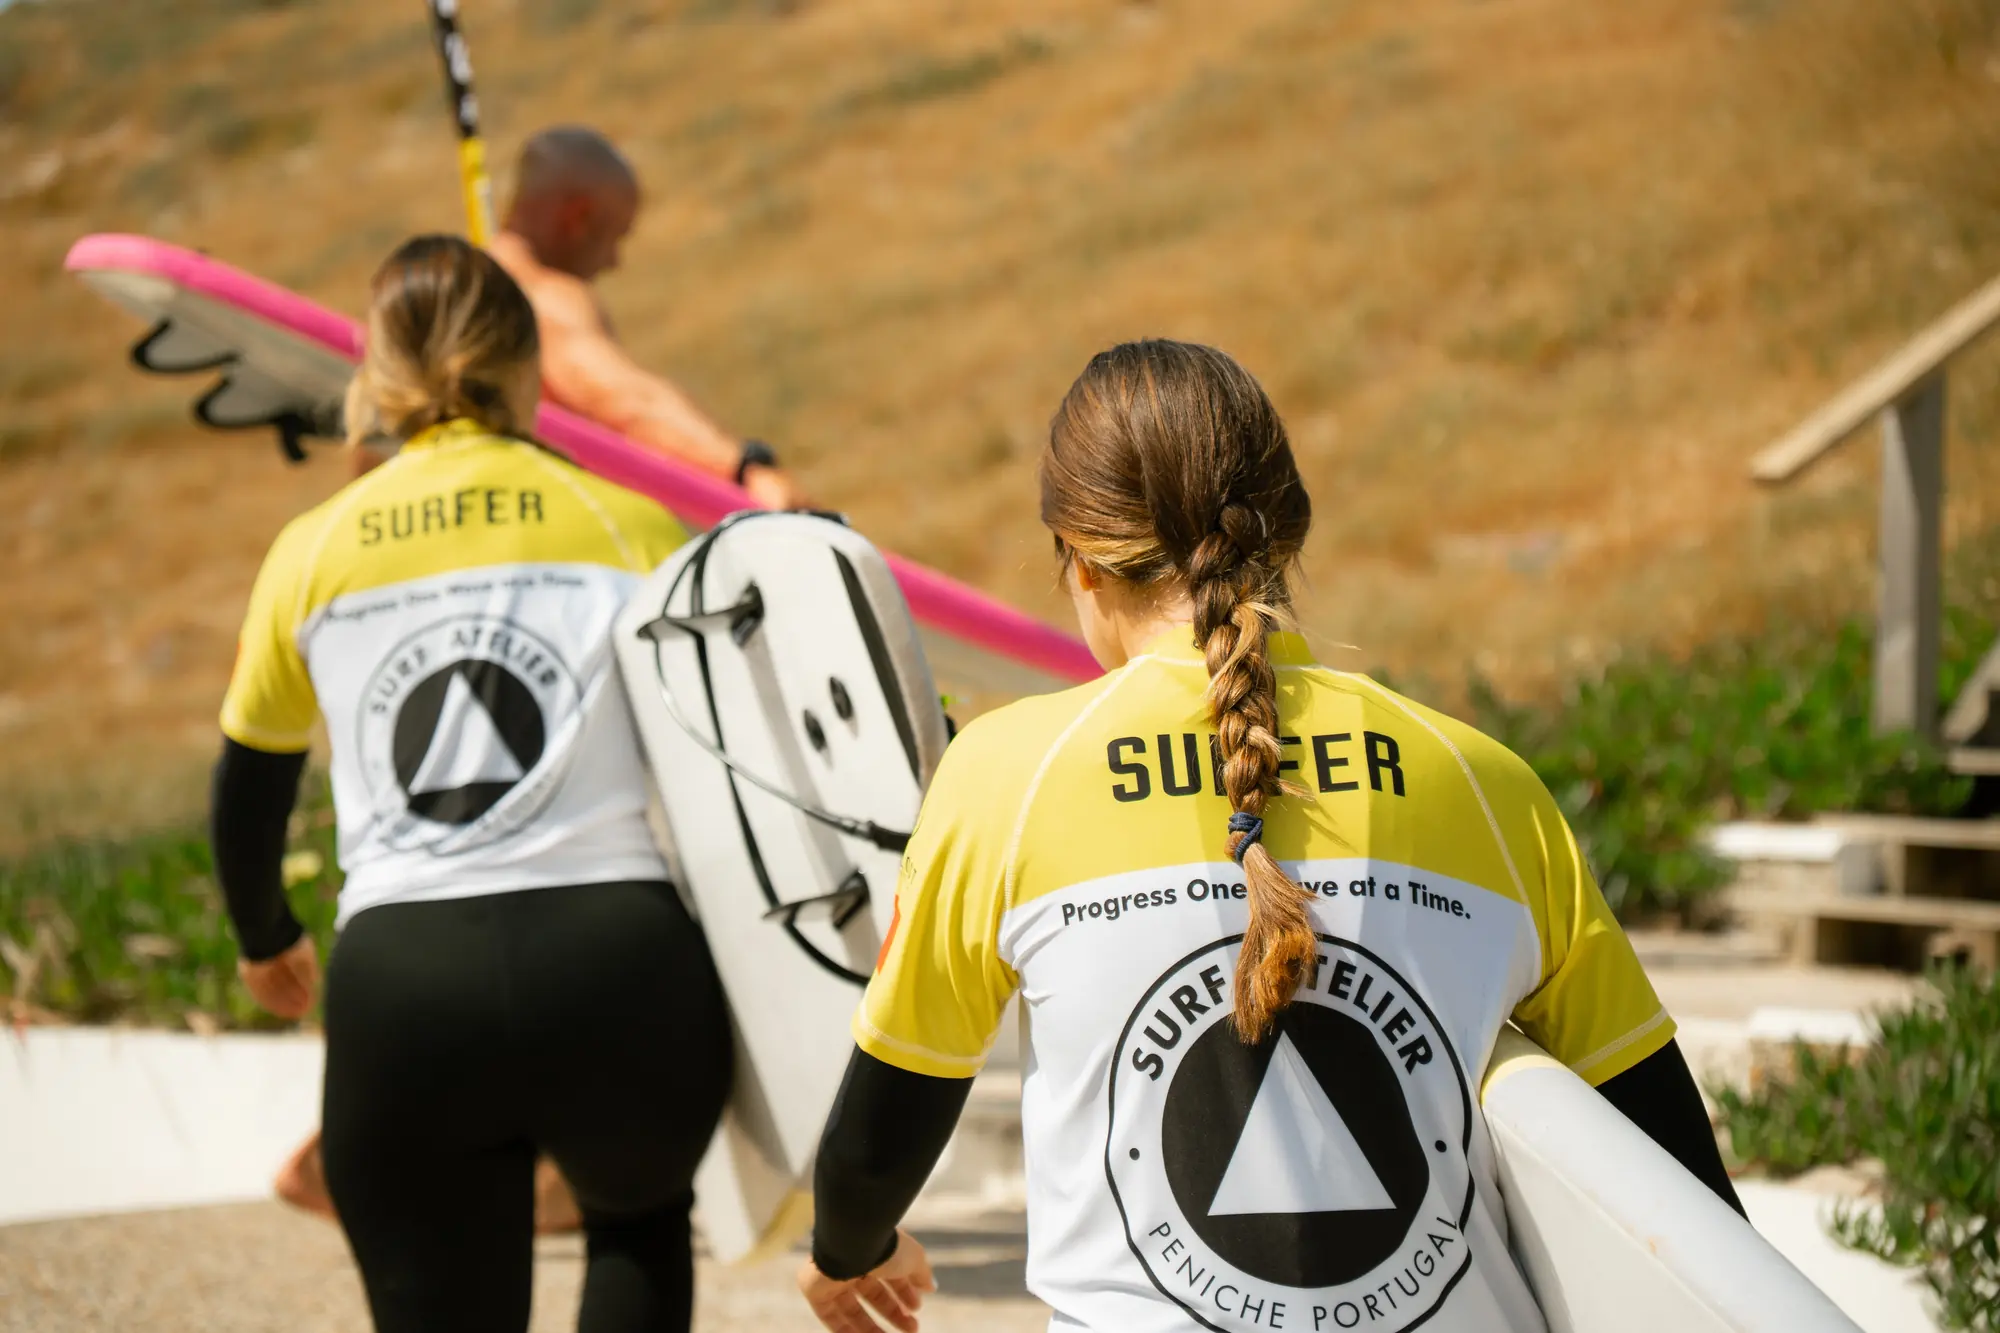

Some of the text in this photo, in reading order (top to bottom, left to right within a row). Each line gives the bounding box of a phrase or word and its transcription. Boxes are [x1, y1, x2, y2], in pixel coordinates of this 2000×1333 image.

[360, 486, 544, 548] SURFER
[371, 647, 427, 714] SURF
[1062, 876, 1472, 927] Progress One ve at a Time.
[1131, 954, 1434, 1082] SURF TELIER
[1148, 1215, 1459, 1332] PENICHE PORTUGAL
